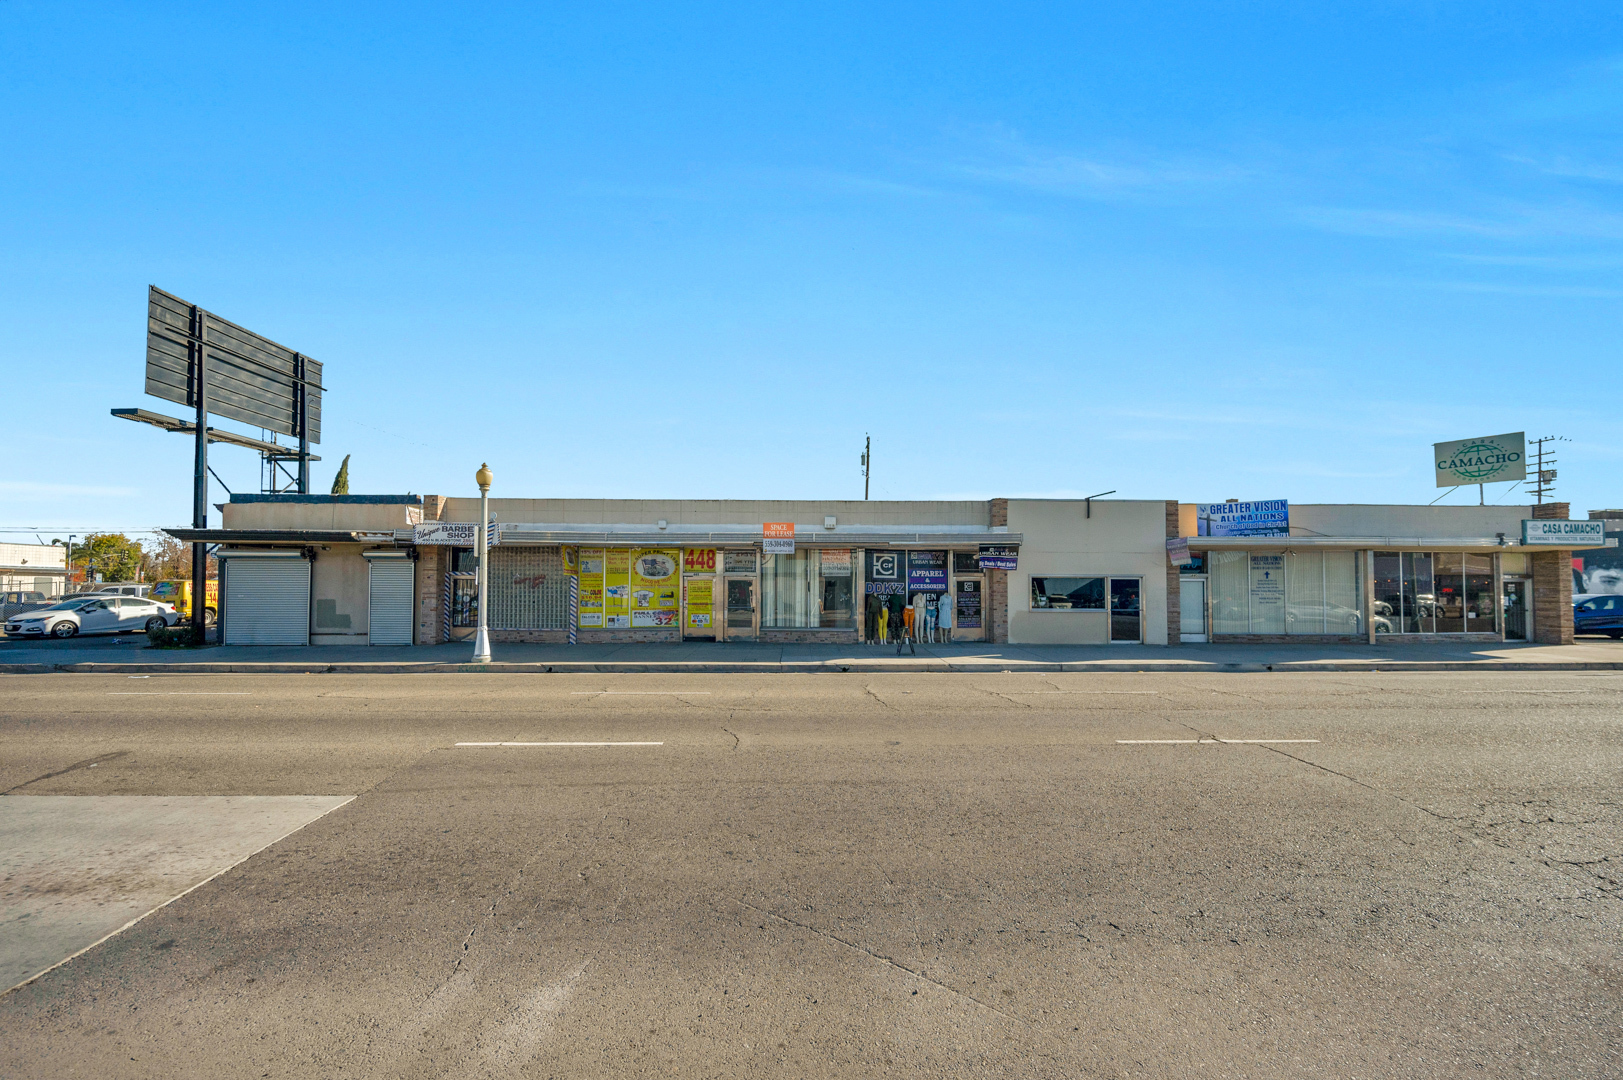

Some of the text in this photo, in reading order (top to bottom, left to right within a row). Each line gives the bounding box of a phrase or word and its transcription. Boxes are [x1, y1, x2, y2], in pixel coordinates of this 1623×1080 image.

[1438, 452, 1520, 470] CAMACHO
[1210, 500, 1286, 514] GREATER VISION
[1240, 512, 1284, 522] NATIONS
[417, 526, 440, 540] Unique
[1542, 524, 1600, 534] CASA CAMACHO
[685, 549, 716, 569] 448
[866, 582, 904, 594] DDK'Z
